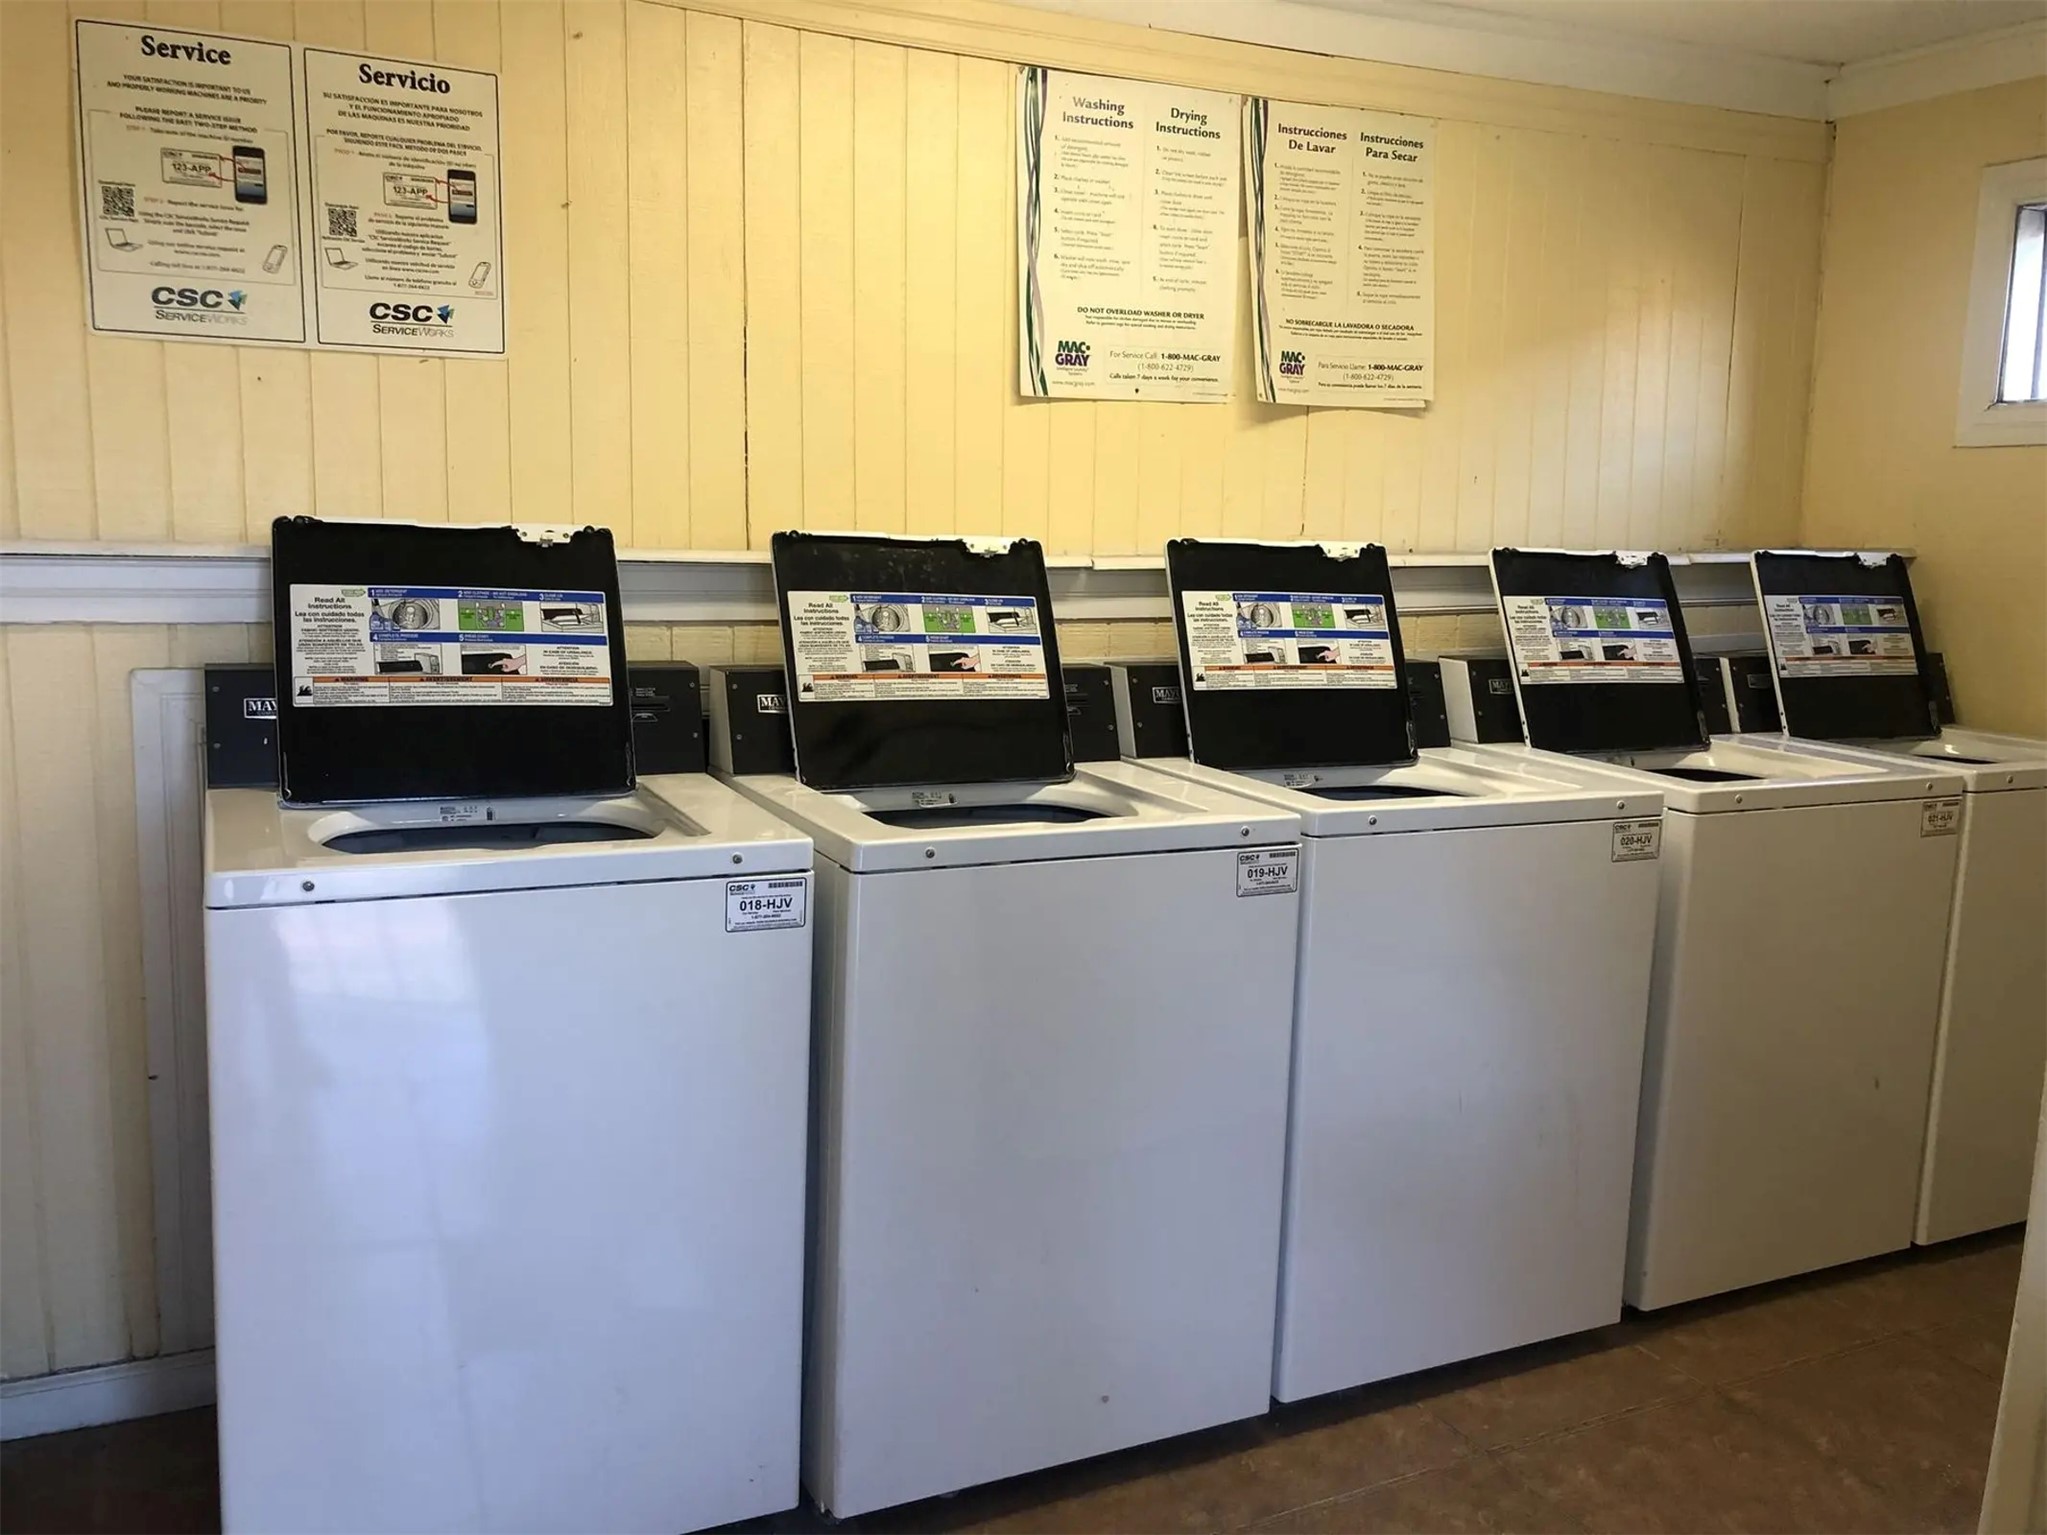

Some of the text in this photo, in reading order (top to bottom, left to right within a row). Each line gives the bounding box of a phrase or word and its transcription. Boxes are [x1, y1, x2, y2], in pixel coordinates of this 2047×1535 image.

[141, 35, 232, 65] Service
[359, 63, 451, 94] Servicio
[122, 83, 153, 92] PROPERLY
[155, 86, 186, 95] WORKING
[187, 90, 219, 100] MACHINES
[239, 97, 266, 105] PRIORITY
[135, 106, 160, 114] PLEASE
[161, 109, 187, 117] REPORT
[195, 113, 221, 122] SERVICE
[362, 105, 421, 118] FUNCIONAMIENTO
[422, 113, 459, 123] APROPIADO
[389, 100, 429, 111] IMPORTANTE
[431, 106, 448, 114] PARA
[449, 108, 482, 118] NOSOTROS
[1072, 96, 1125, 116] Washing
[119, 112, 160, 122] FOLLOWING
[194, 121, 227, 130] TWO-STEP
[228, 125, 257, 134] METHOD
[1062, 112, 1134, 130] Instructions
[1170, 107, 1208, 126] Drying
[406, 119, 434, 127] NUESTRA
[436, 122, 470, 132] PRIORIDAD
[1155, 121, 1221, 140] Instructions
[1278, 123, 1347, 141] Instrucciones
[344, 137, 374, 146] SIGUIENDO
[360, 132, 384, 140] REPORTE
[385, 135, 415, 144] CUALQUIER
[416, 139, 445, 148] PROBLEMA
[1288, 139, 1336, 154] De Lavar
[1360, 132, 1424, 149] Instrucciones
[1365, 147, 1418, 163] Para Secar
[171, 162, 211, 174] 123-APP
[393, 185, 429, 197] 123-APP
[151, 286, 224, 309] CSC
[369, 302, 433, 323] CSC
[1077, 306, 1089, 314] DO
[1090, 307, 1105, 315] NOT
[1106, 308, 1143, 317] OVERLOAD
[1144, 310, 1171, 318] WASHER
[1183, 312, 1205, 320] DRYER
[1295, 319, 1334, 328] SOBRECARGUE
[1343, 322, 1375, 330] LAVADORA
[1055, 353, 1090, 366] GRAY
[1122, 352, 1143, 360] Service
[1161, 352, 1221, 362] 1-800-MAC-GRAY
[1137, 362, 1194, 372] (1-800-622-4729)
[1279, 362, 1305, 376] GRAY
[1318, 362, 1328, 370] Para
[1329, 362, 1349, 370] Servicio
[1368, 364, 1424, 372] 1-800-MAC-GRAY
[1620, 835, 1653, 846] 020-HJV
[1247, 866, 1288, 879] 019-HJV
[729, 884, 750, 892] CSC
[739, 897, 793, 911] 018-HJV
